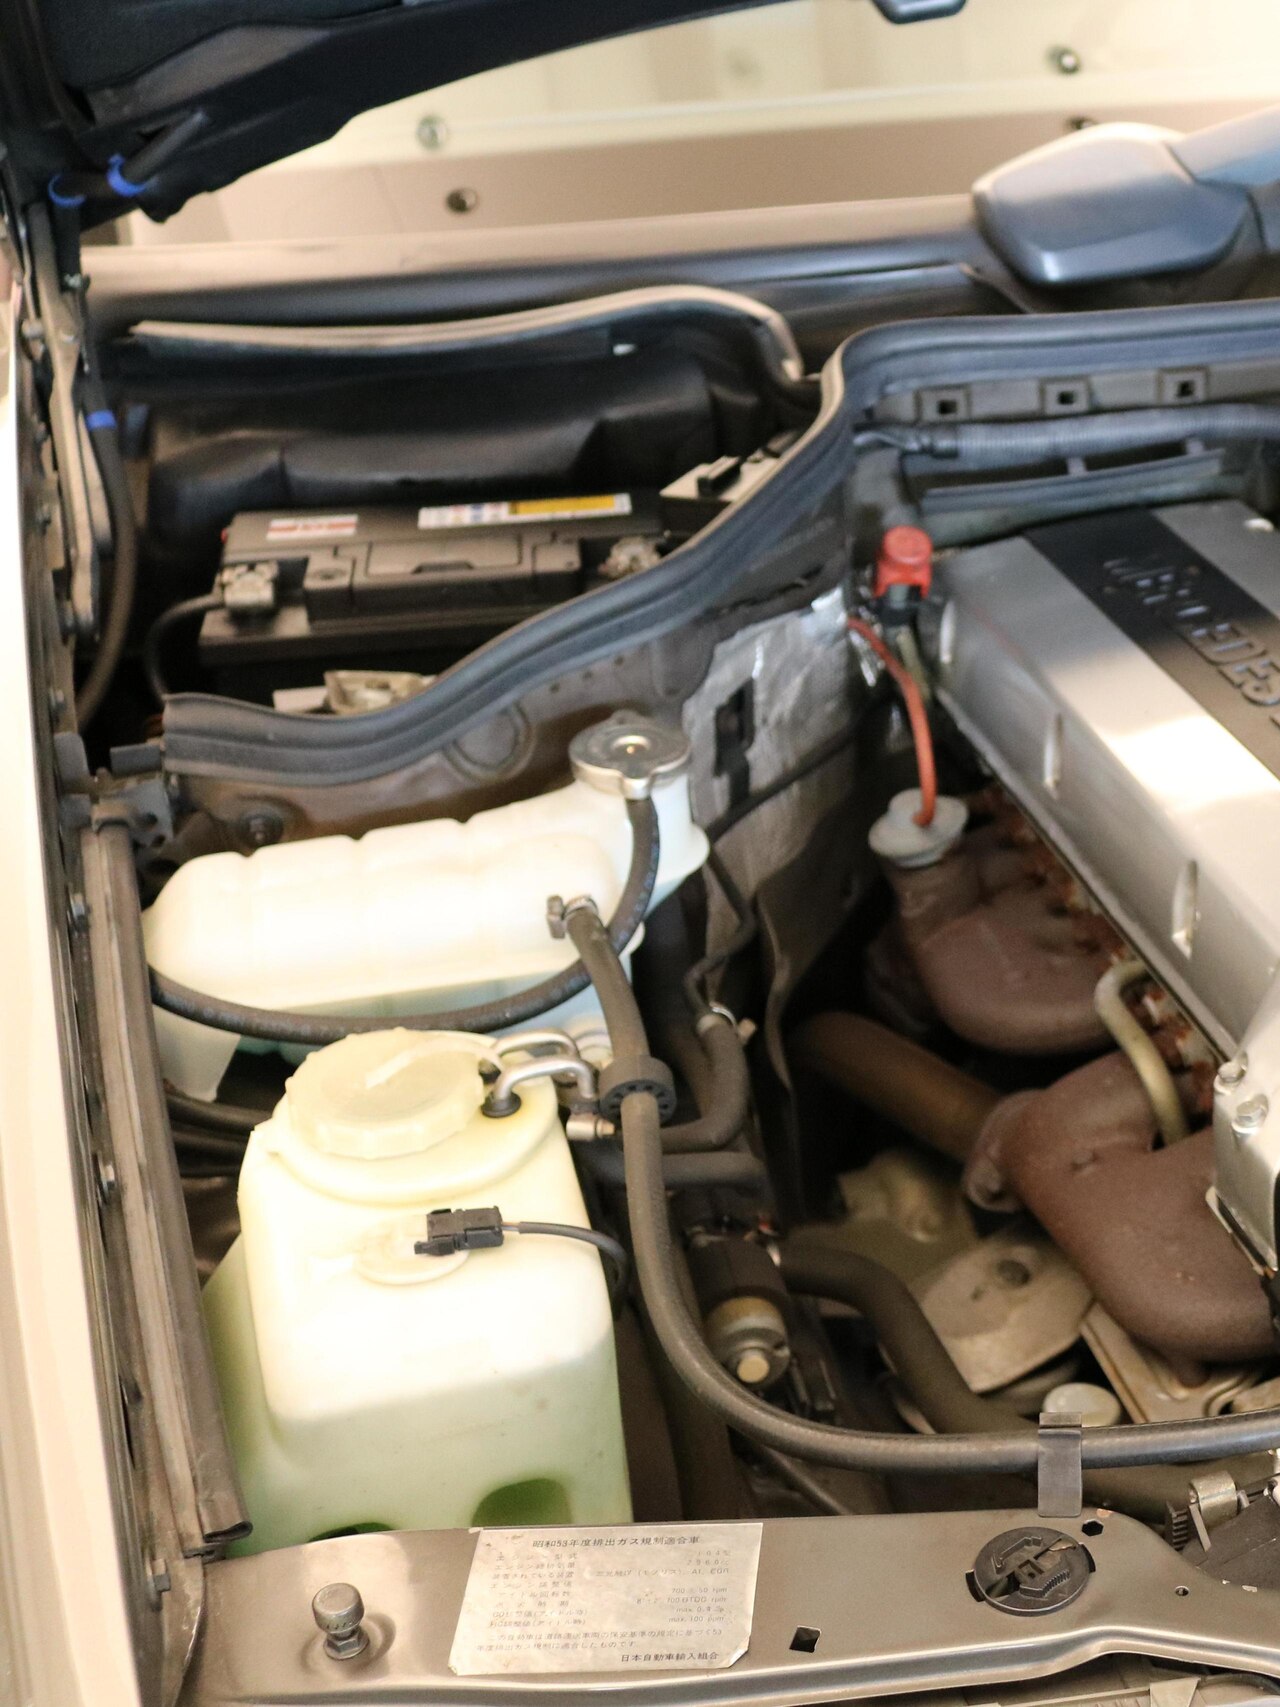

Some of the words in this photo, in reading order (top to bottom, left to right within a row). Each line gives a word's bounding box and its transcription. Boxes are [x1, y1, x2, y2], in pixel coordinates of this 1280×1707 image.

[620, 1651, 719, 1662] 日本自動車輸入組合
